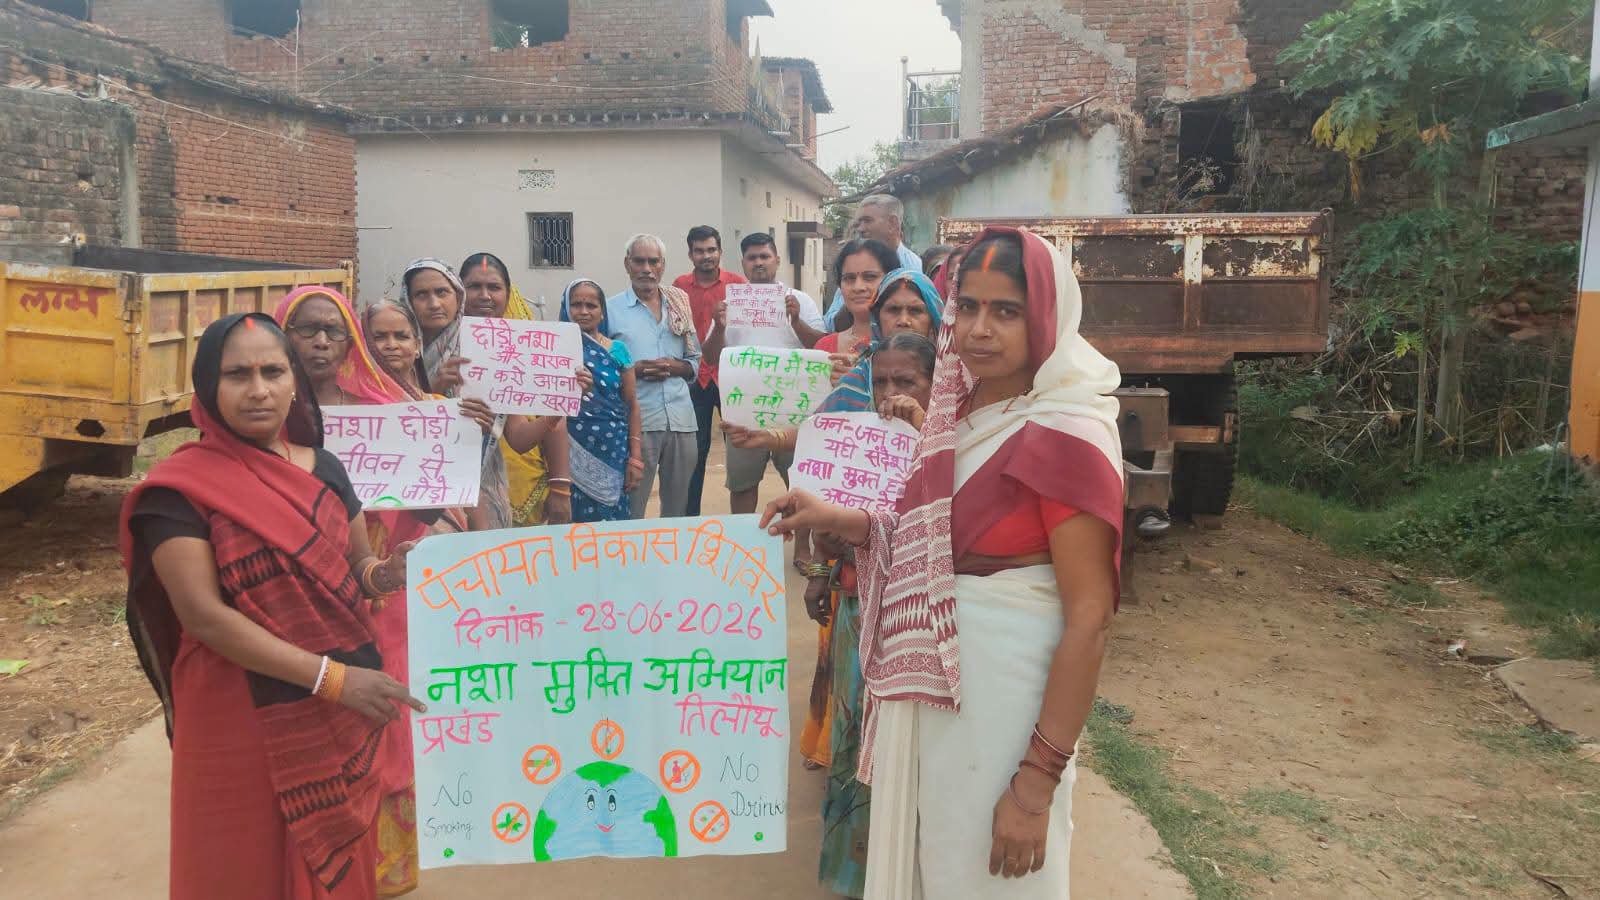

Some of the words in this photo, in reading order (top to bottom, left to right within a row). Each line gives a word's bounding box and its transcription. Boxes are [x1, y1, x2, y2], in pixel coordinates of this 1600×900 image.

[20, 286, 110, 318] लाभ
[518, 330, 560, 351] नशा
[468, 366, 488, 381] न
[533, 373, 578, 392] अपना
[489, 386, 539, 407] जीवन
[323, 415, 387, 440] नशा
[890, 433, 917, 453] का
[419, 444, 454, 480] से
[797, 459, 835, 480] नशा
[416, 536, 558, 611] पंचायत
[564, 522, 680, 571] विकास
[686, 519, 785, 622] शिविर
[454, 606, 545, 649] दिनांक
[576, 599, 764, 641] 28-06-2026
[426, 662, 519, 704] नशा
[531, 648, 633, 714] मुक्ति
[643, 647, 788, 695] अभियान
[417, 707, 501, 755] प्रखंड
[719, 751, 760, 783] No
[432, 771, 473, 808] No
[730, 790, 786, 818] Drink
